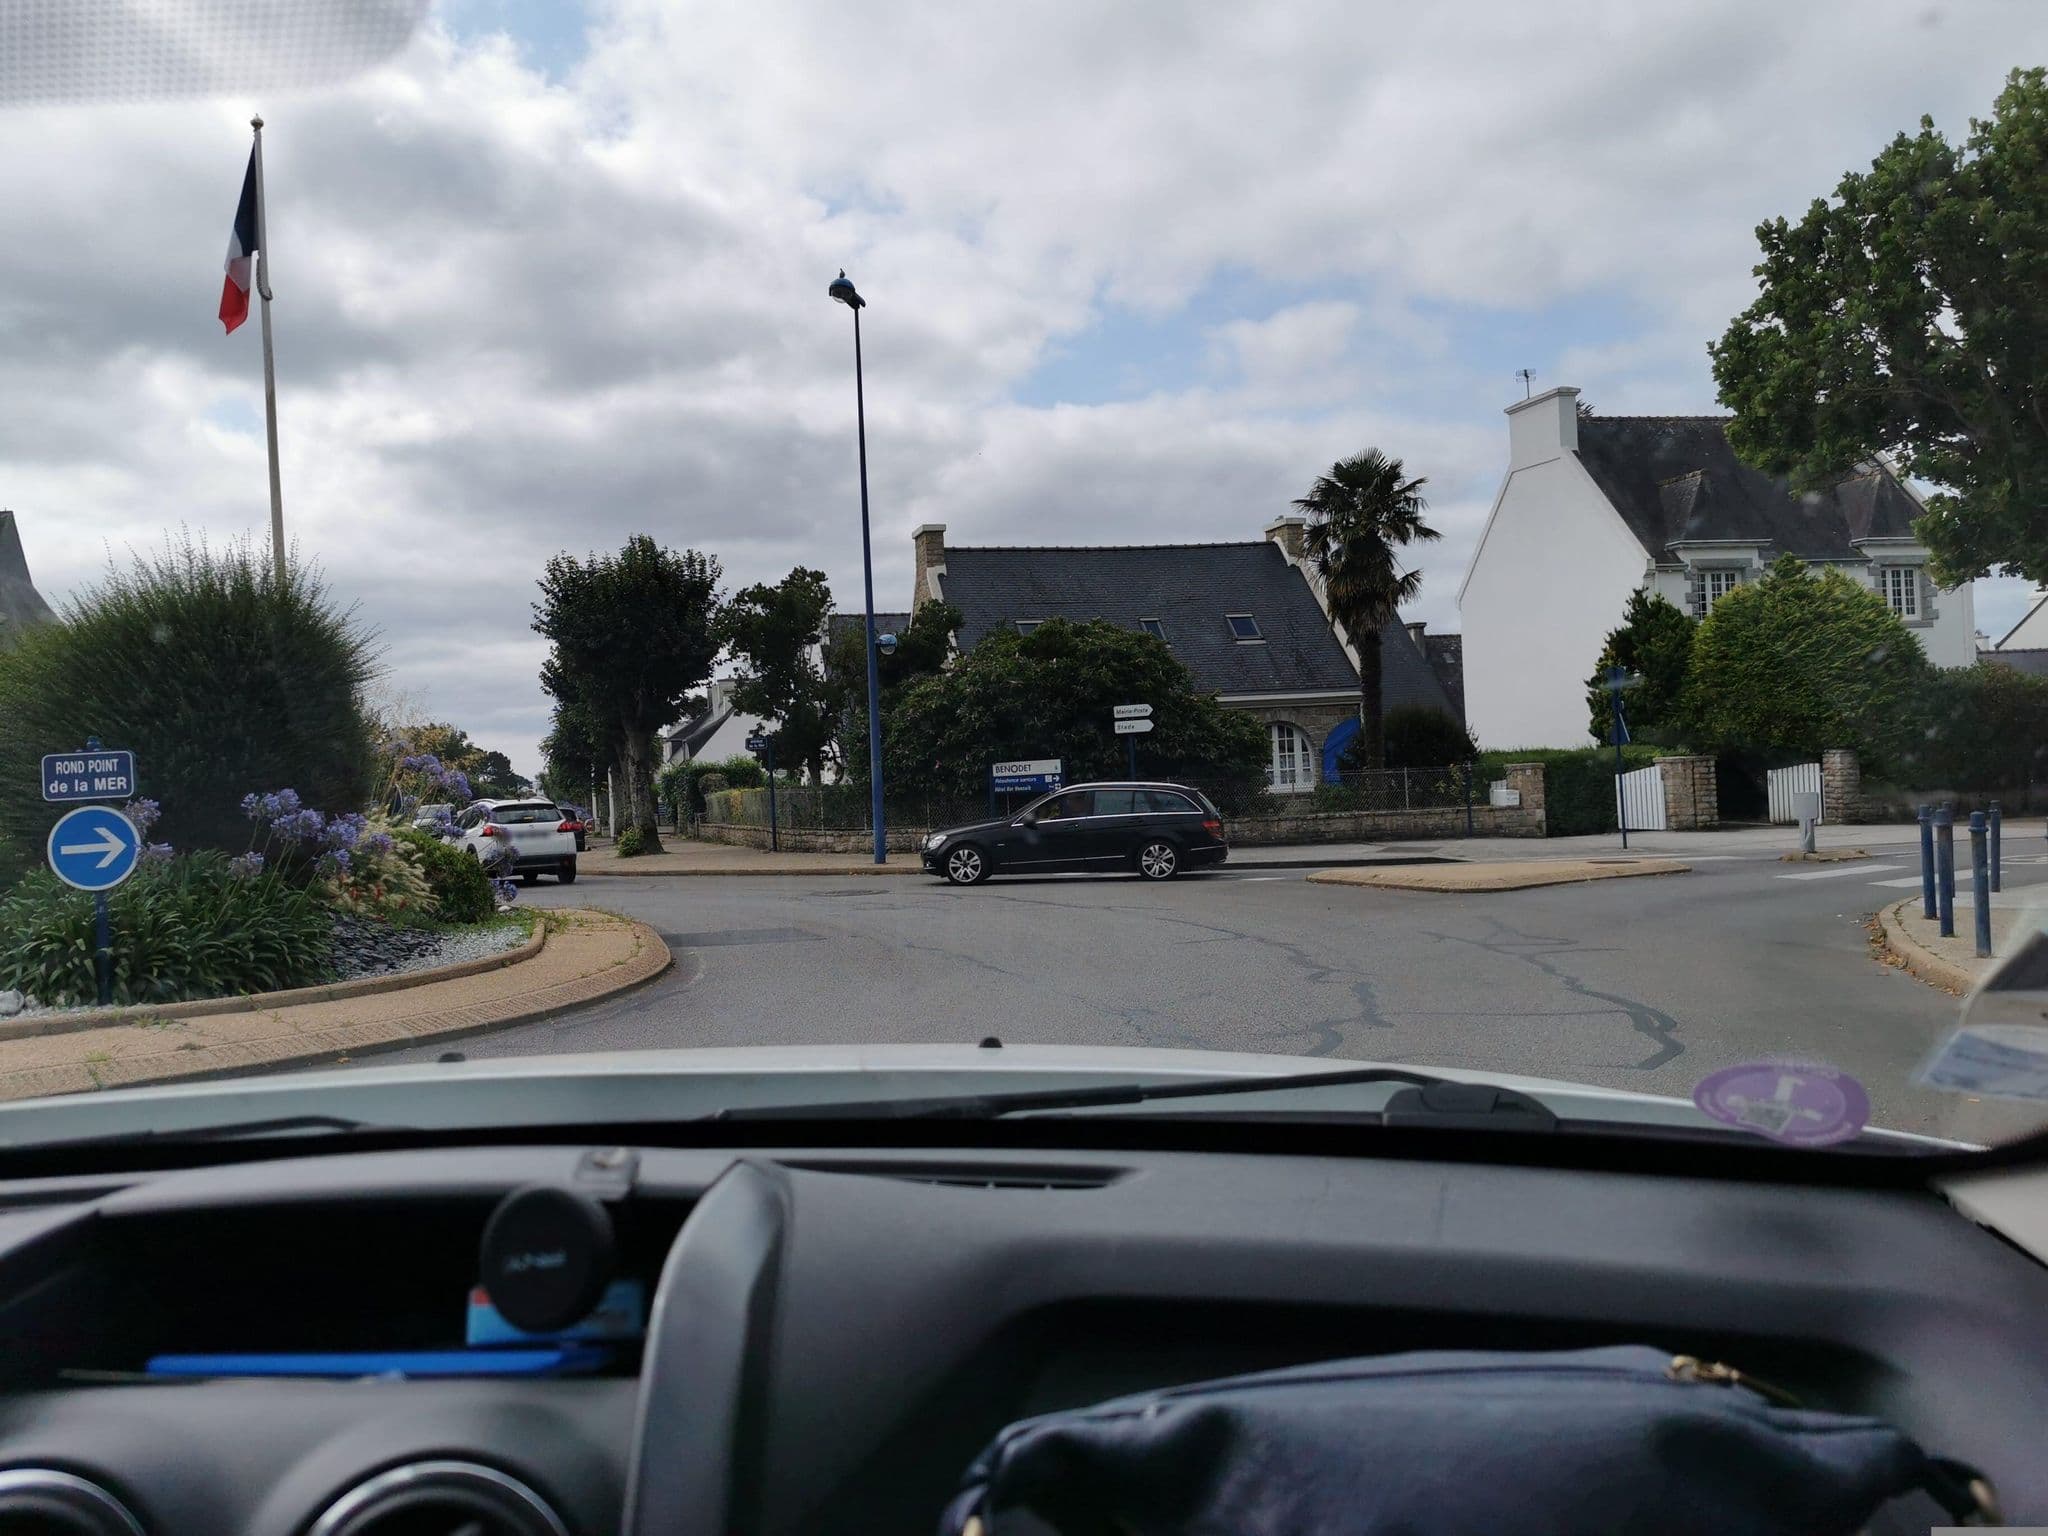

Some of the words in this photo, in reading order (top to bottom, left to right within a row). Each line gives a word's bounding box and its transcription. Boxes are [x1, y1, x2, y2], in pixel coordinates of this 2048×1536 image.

[55, 760, 85, 775] ROND
[88, 758, 119, 773] POINT
[995, 764, 1031, 774] BENODET
[49, 780, 69, 793] de
[74, 779, 88, 792] la
[94, 776, 127, 791] MER
